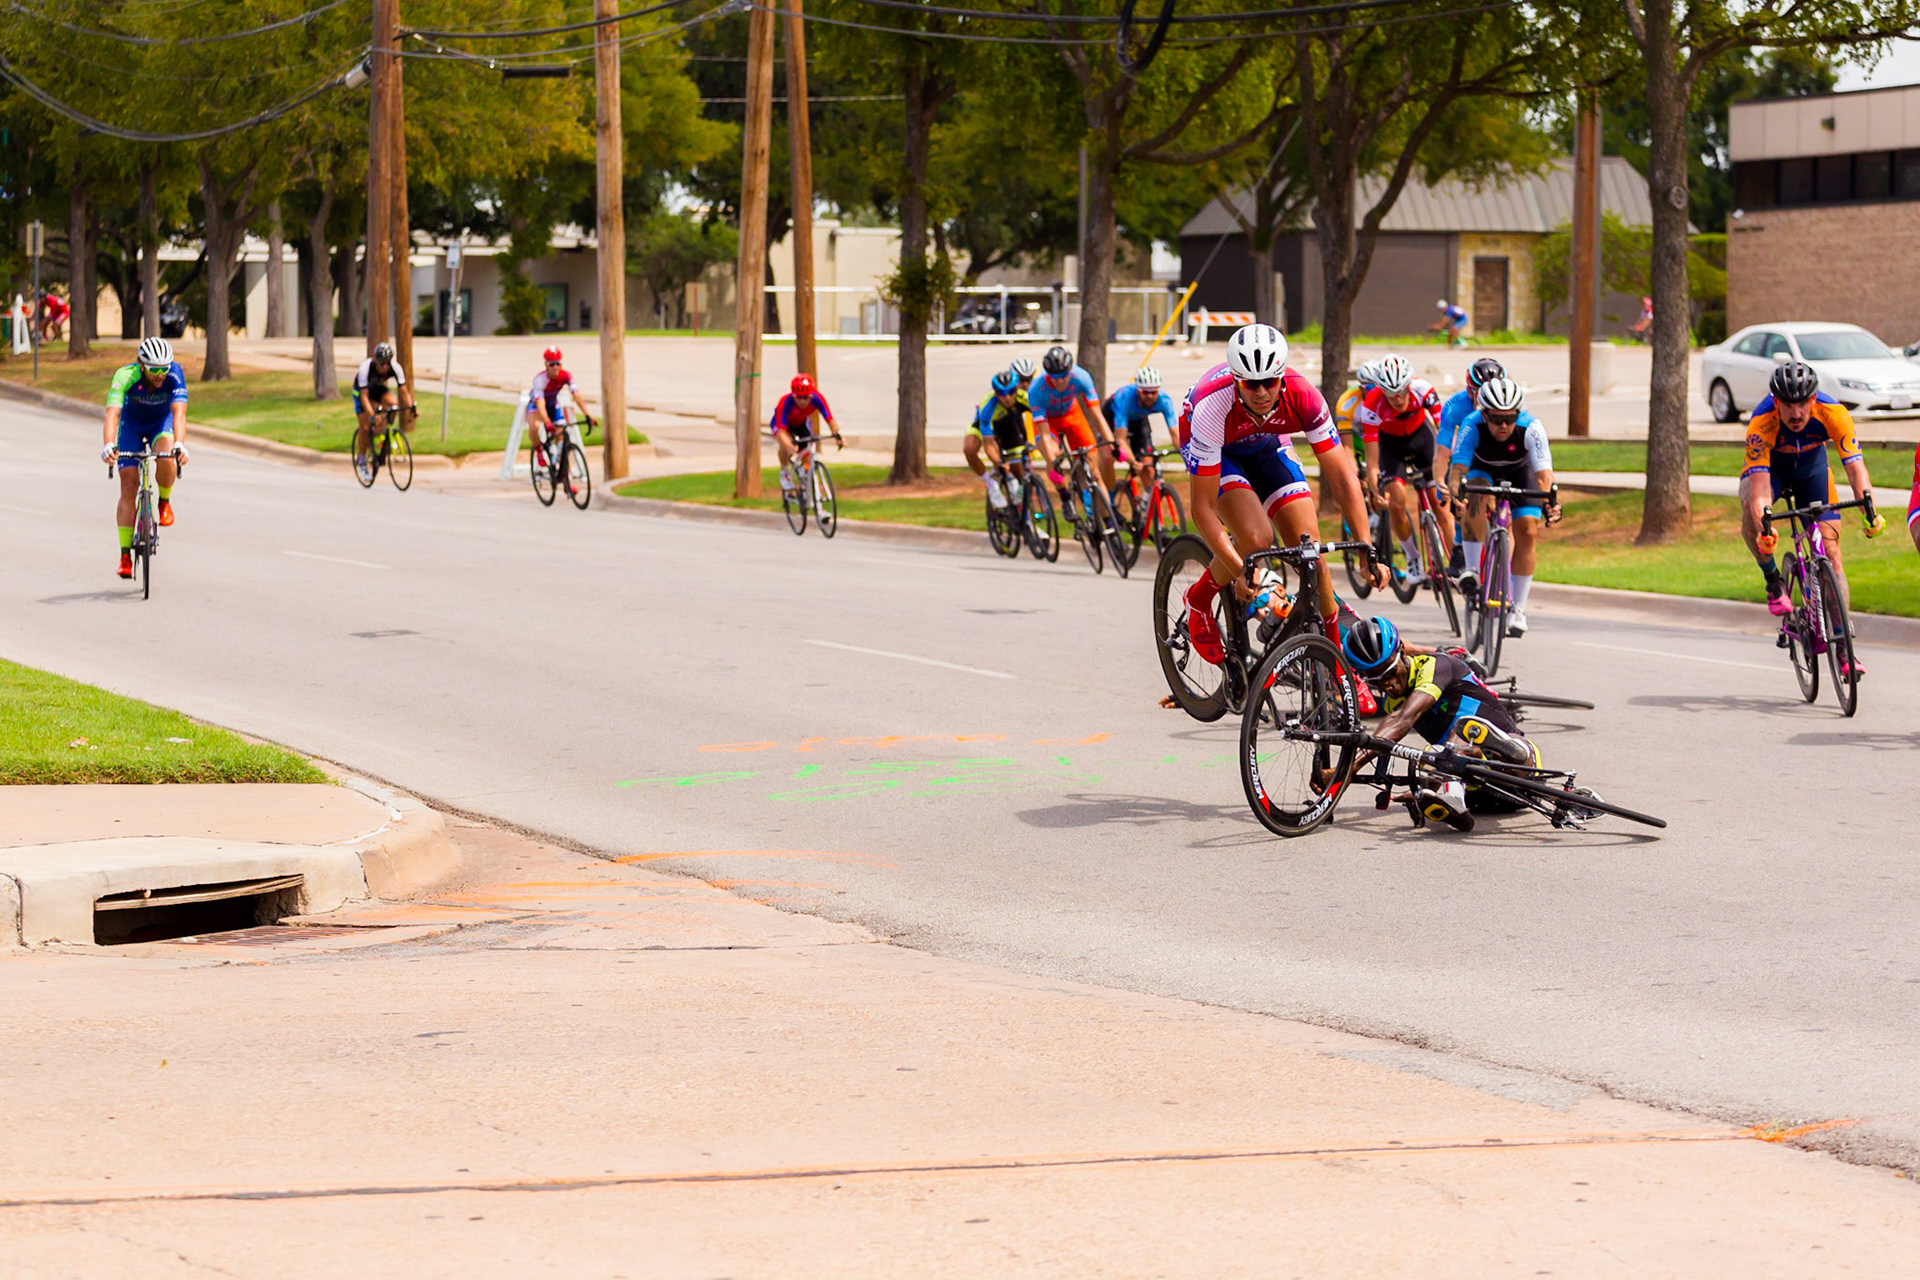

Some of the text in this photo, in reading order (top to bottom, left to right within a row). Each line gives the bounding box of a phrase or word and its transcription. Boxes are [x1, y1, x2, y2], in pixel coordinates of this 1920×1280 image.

[1272, 644, 1309, 678] MERCURY
[1339, 673, 1357, 728] MERCURY
[1390, 743, 1424, 761] GIANT
[1248, 744, 1265, 800] MERCURY
[1298, 792, 1333, 827] MERCURY
